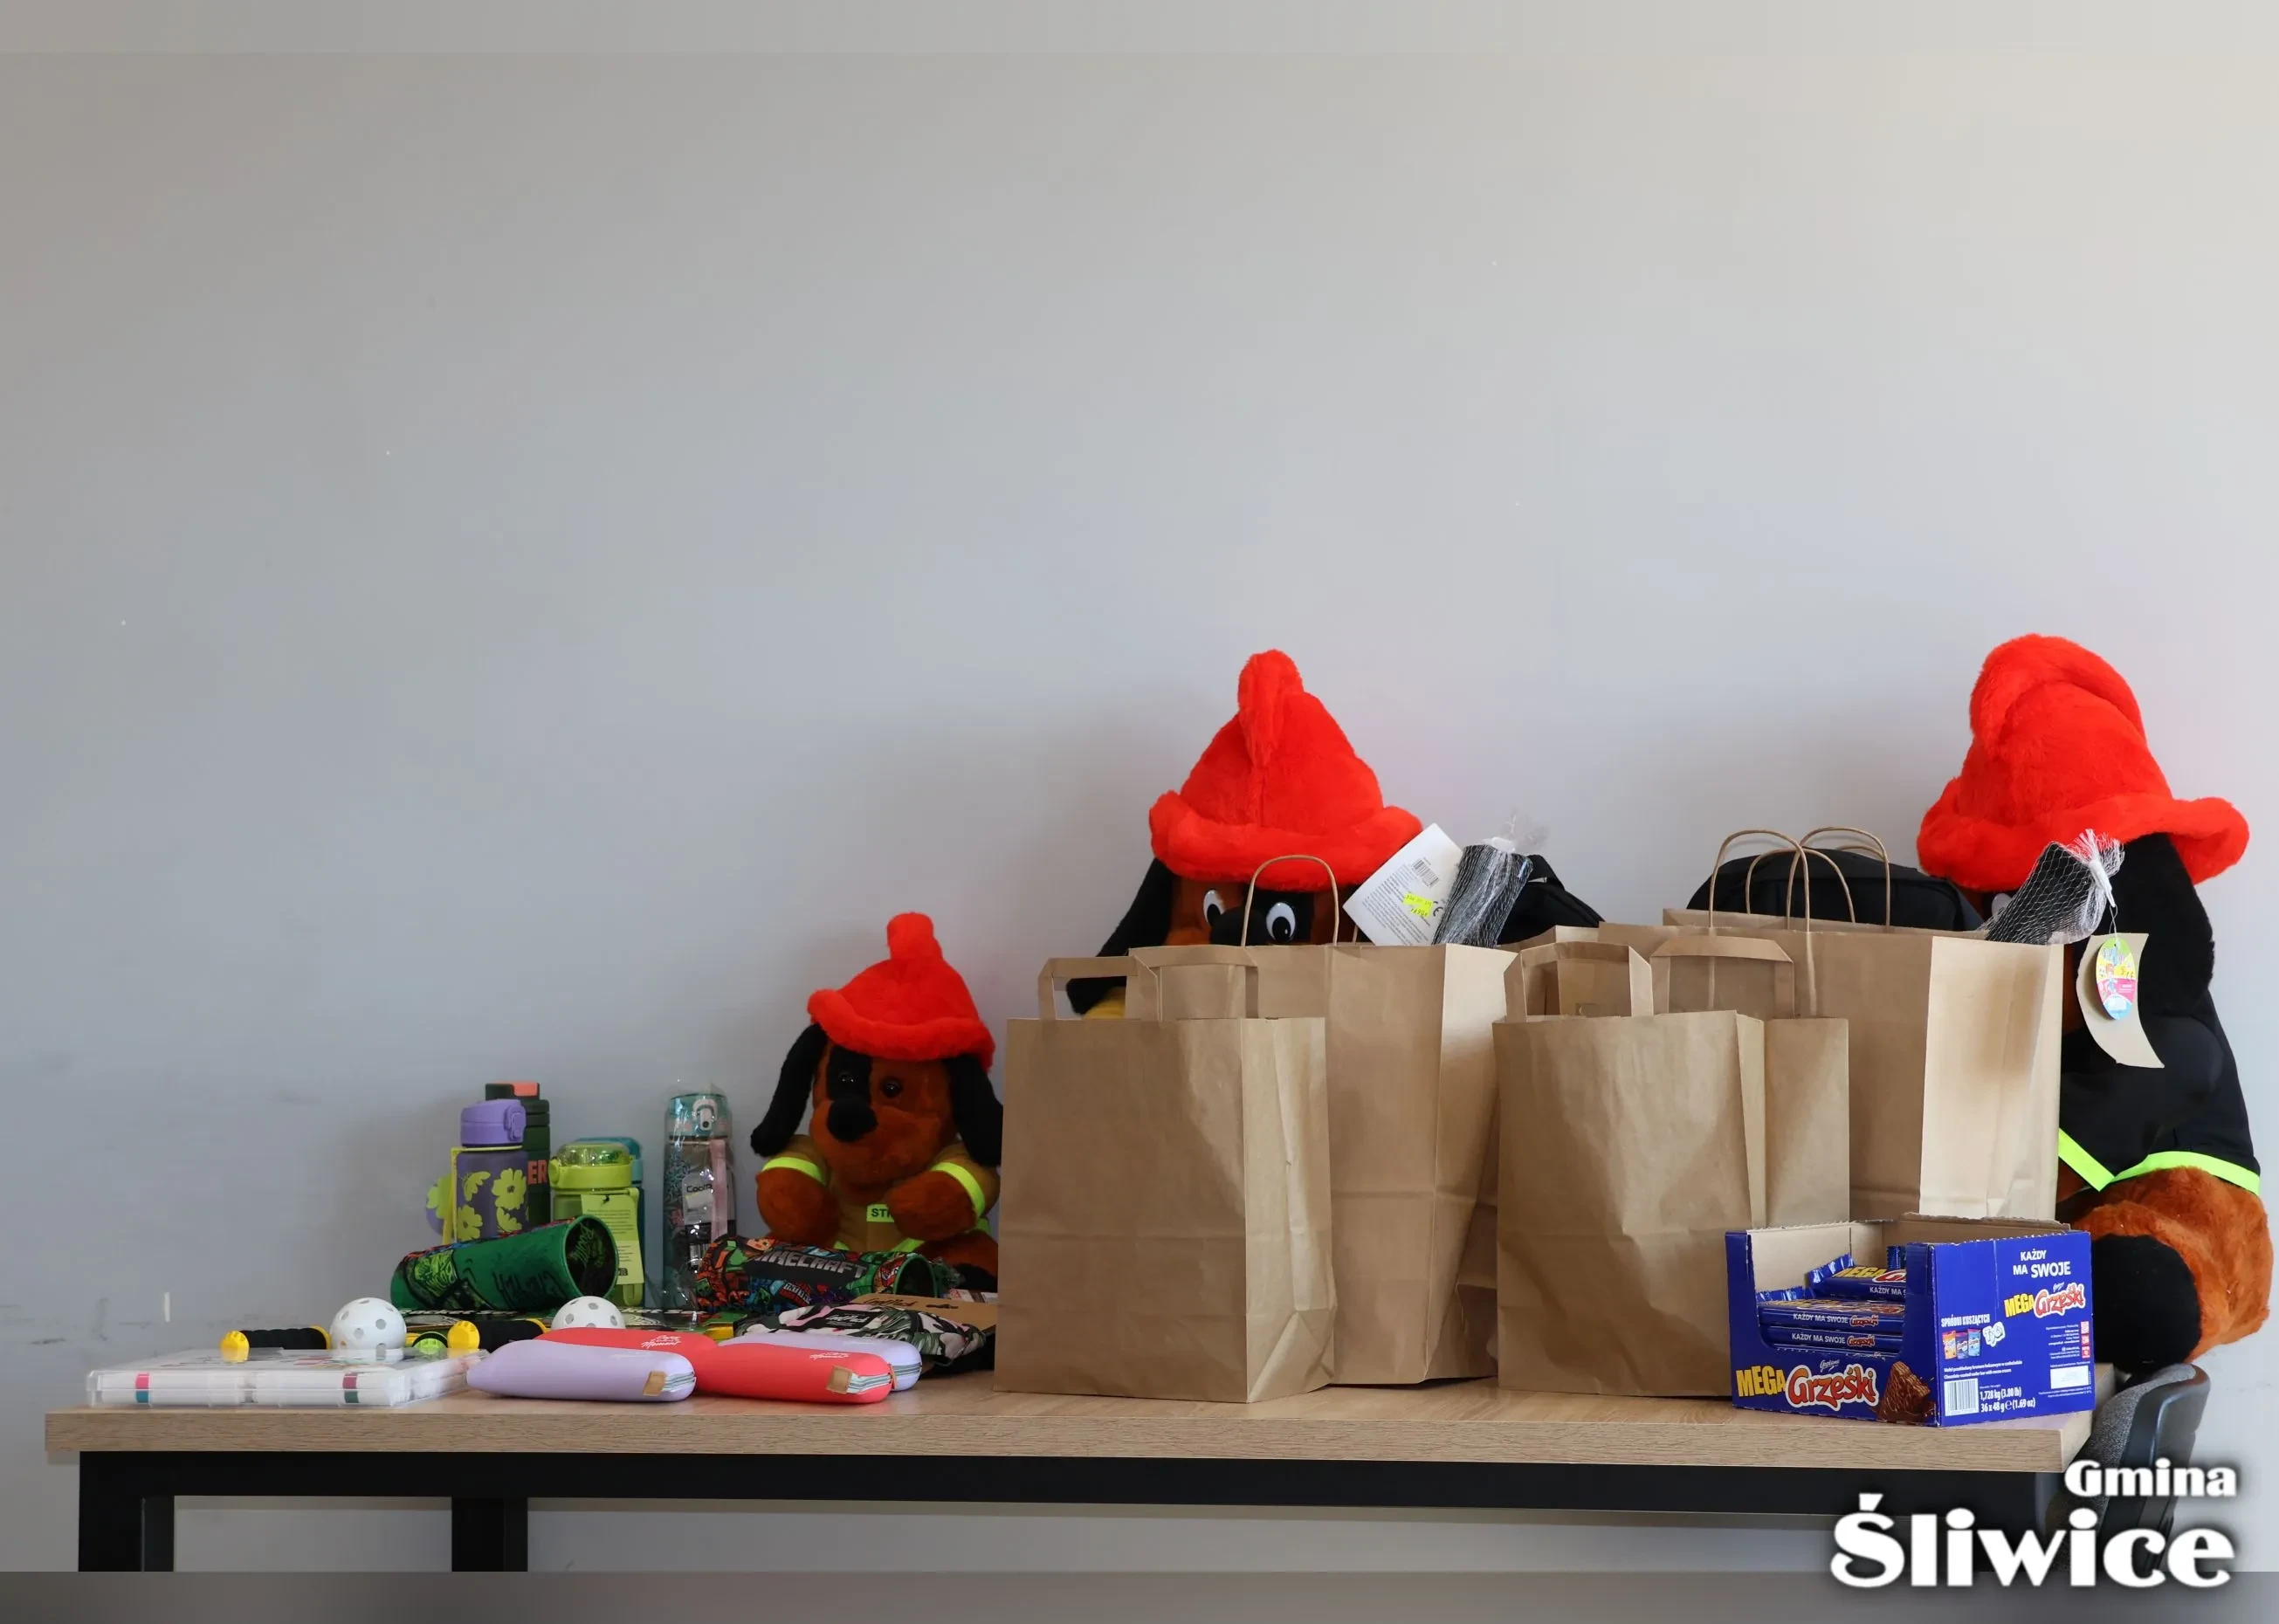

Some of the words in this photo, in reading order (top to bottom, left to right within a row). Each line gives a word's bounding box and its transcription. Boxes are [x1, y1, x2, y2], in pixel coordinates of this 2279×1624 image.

[686, 1183, 713, 1193] CoolP
[2020, 1248, 2047, 1262] KAŻDY
[2013, 1263, 2028, 1276] MA
[2030, 1261, 2071, 1278] SWOJE
[1869, 1286, 1890, 1295] KAŻDY
[2004, 1293, 2035, 1318] MEGA
[2035, 1283, 2085, 1318] Grześki
[1793, 1312, 1814, 1321] KAŻDY
[1792, 1332, 1812, 1340] KAŻDY
[1825, 1335, 1845, 1344] SWOJE
[1735, 1365, 1786, 1397] MEGA
[1787, 1365, 1878, 1410] Grześki
[1979, 1389, 1993, 1401] 1,728
[1993, 1388, 2000, 1400] kg
[1980, 1402, 1988, 1413] 36
[1993, 1401, 2000, 1411] 48
[2000, 1402, 2005, 1413] g
[2012, 1399, 2027, 1410] (1.69
[2027, 1397, 2036, 1407] oz)
